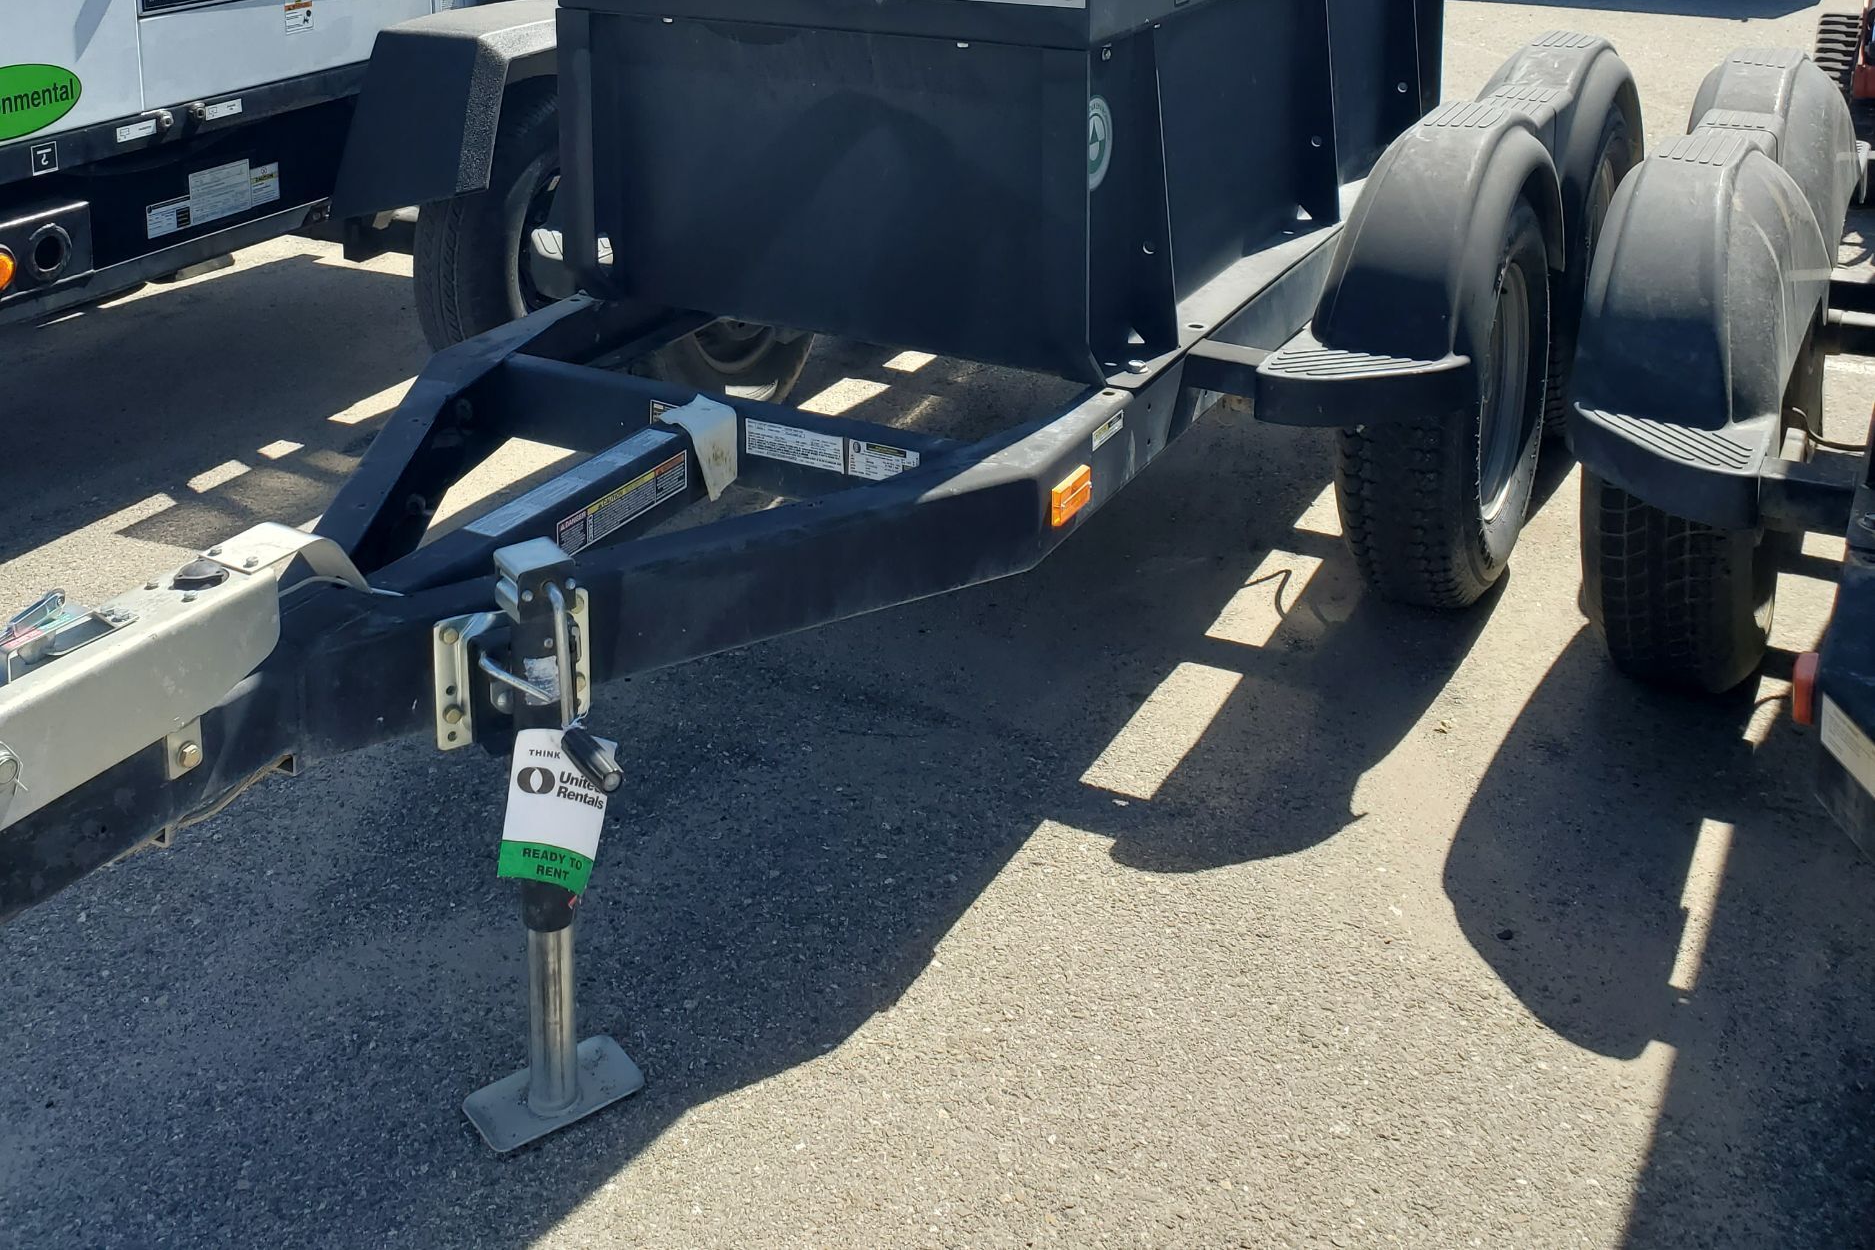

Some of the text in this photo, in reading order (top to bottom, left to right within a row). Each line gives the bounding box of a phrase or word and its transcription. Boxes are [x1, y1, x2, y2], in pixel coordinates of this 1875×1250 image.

[0, 78, 74, 114] nmental
[529, 749, 561, 760] THINK
[559, 771, 603, 793] Unite
[556, 785, 604, 810] Rentals
[522, 847, 583, 871] READY TO
[536, 864, 570, 881] RENT
